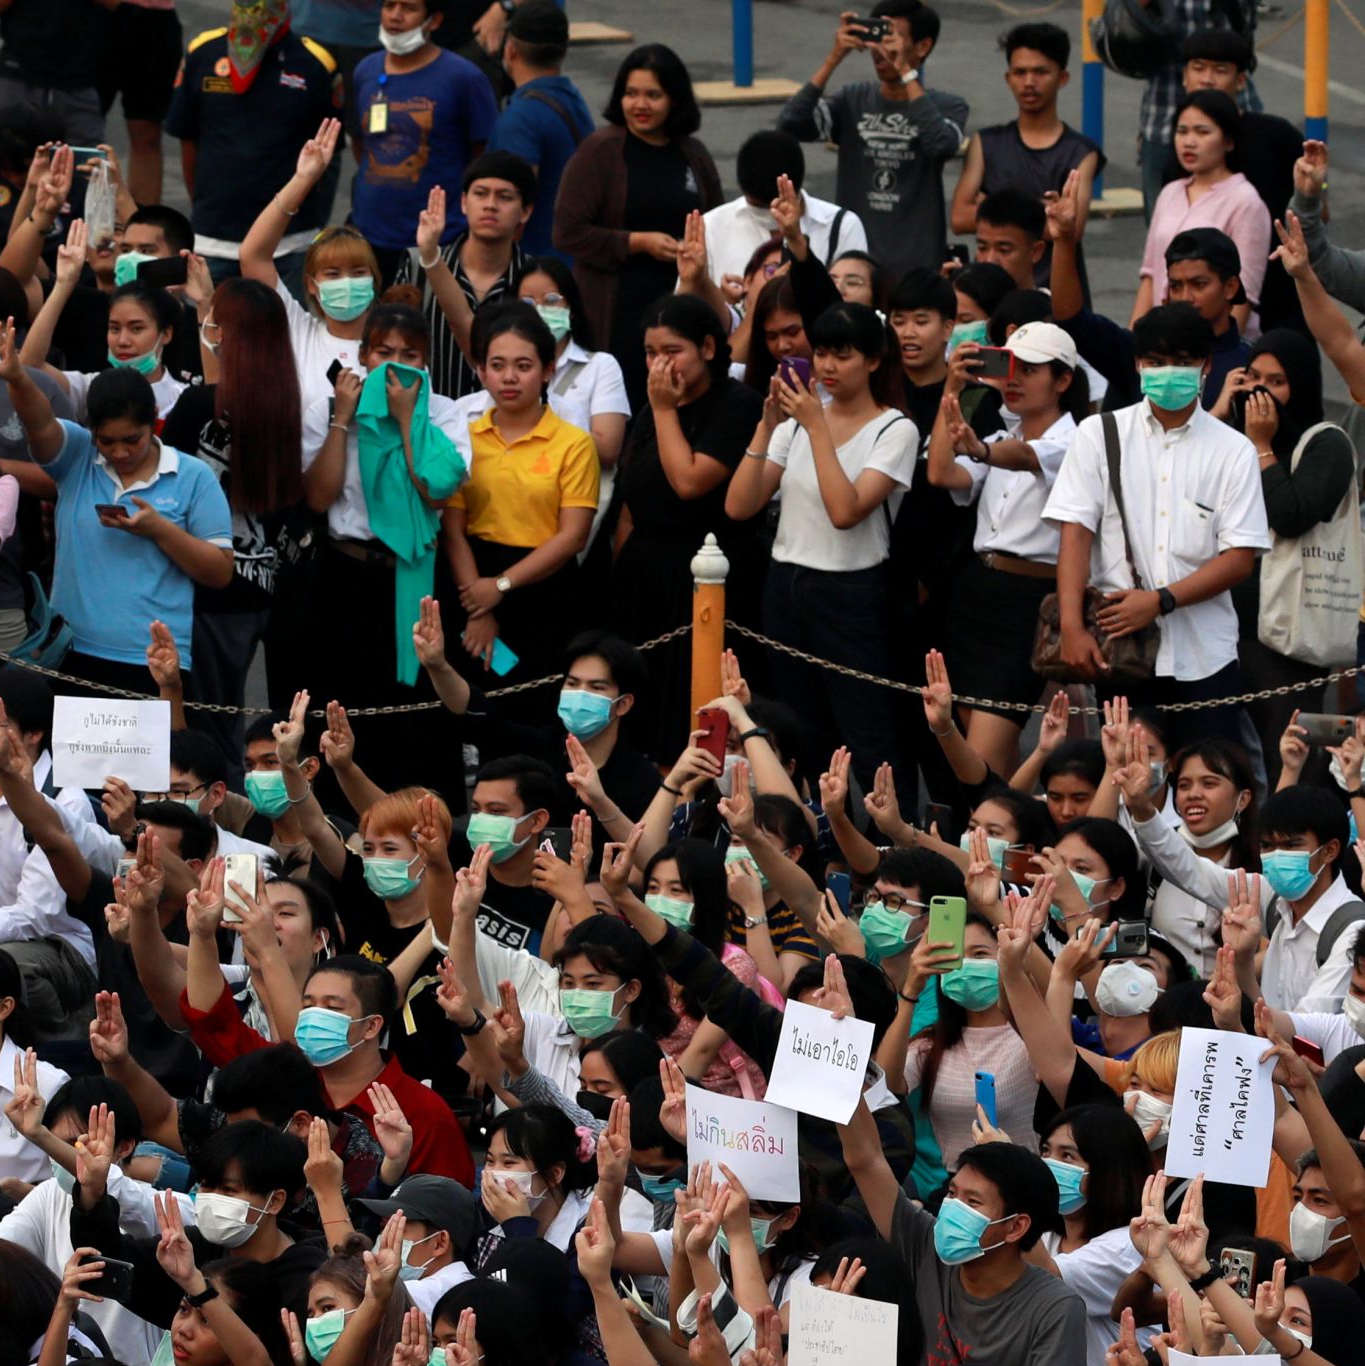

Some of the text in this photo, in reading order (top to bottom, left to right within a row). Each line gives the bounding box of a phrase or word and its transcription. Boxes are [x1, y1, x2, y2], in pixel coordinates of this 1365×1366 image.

[791, 1025, 858, 1072] ไม่เอาไอโอ
[691, 1105, 785, 1155] ไม่กินสลิ่ม
